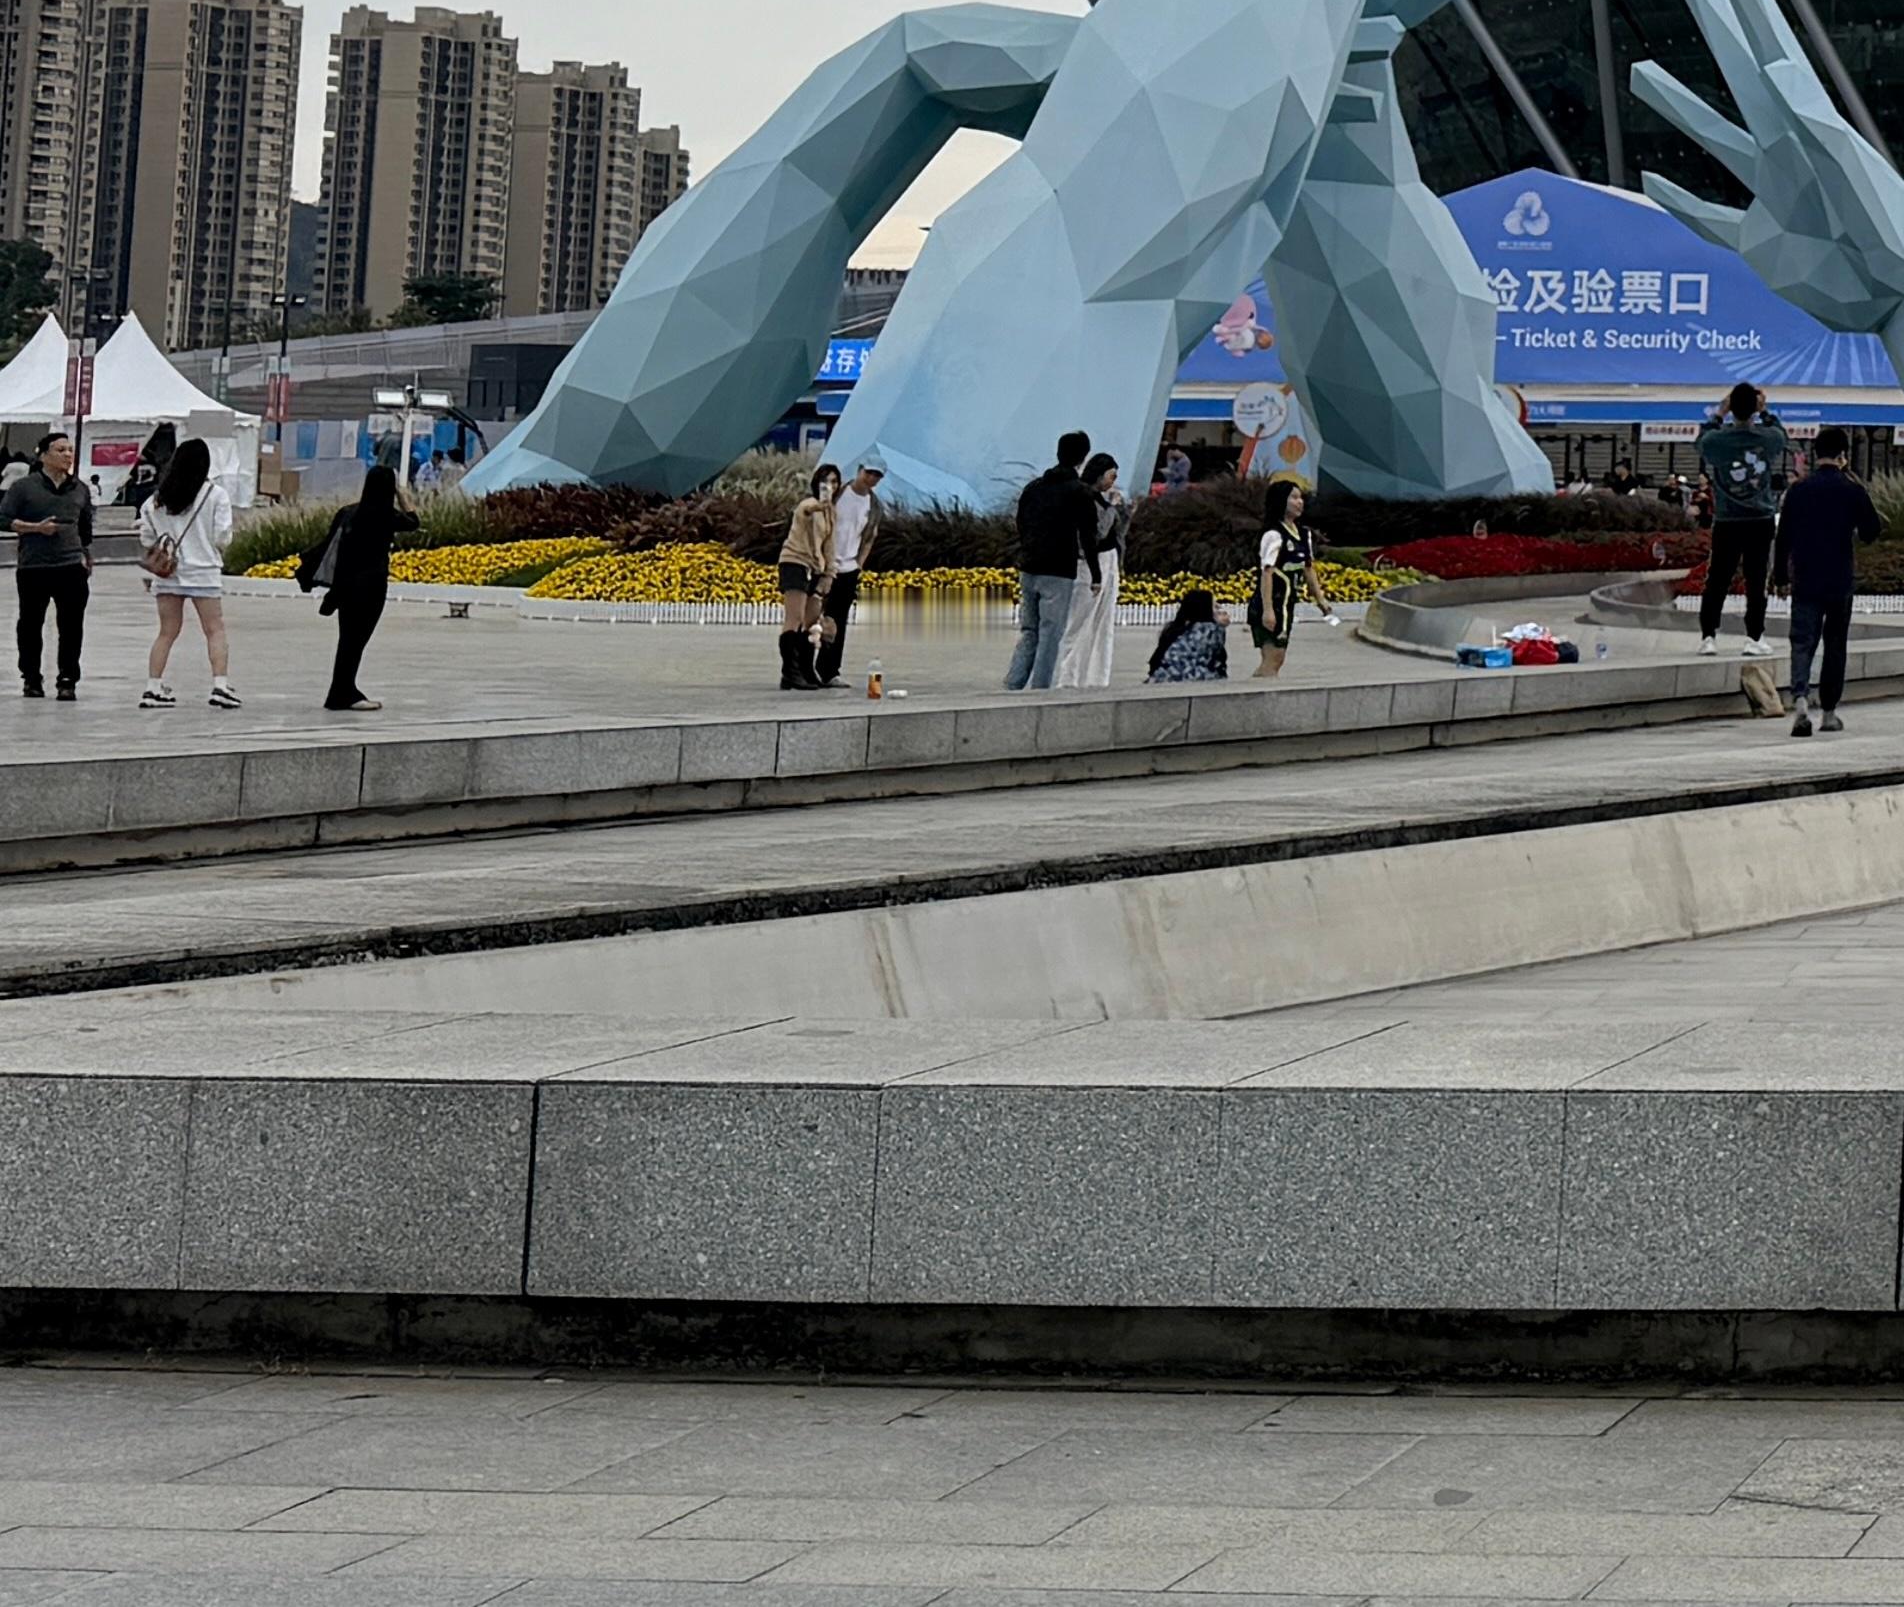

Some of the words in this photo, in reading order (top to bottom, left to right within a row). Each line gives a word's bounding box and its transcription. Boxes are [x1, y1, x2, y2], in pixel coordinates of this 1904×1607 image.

[1511, 327, 1577, 349] Ticket
[1582, 329, 1598, 348] &
[1604, 328, 1690, 354] Security
[1696, 329, 1761, 350] Check
